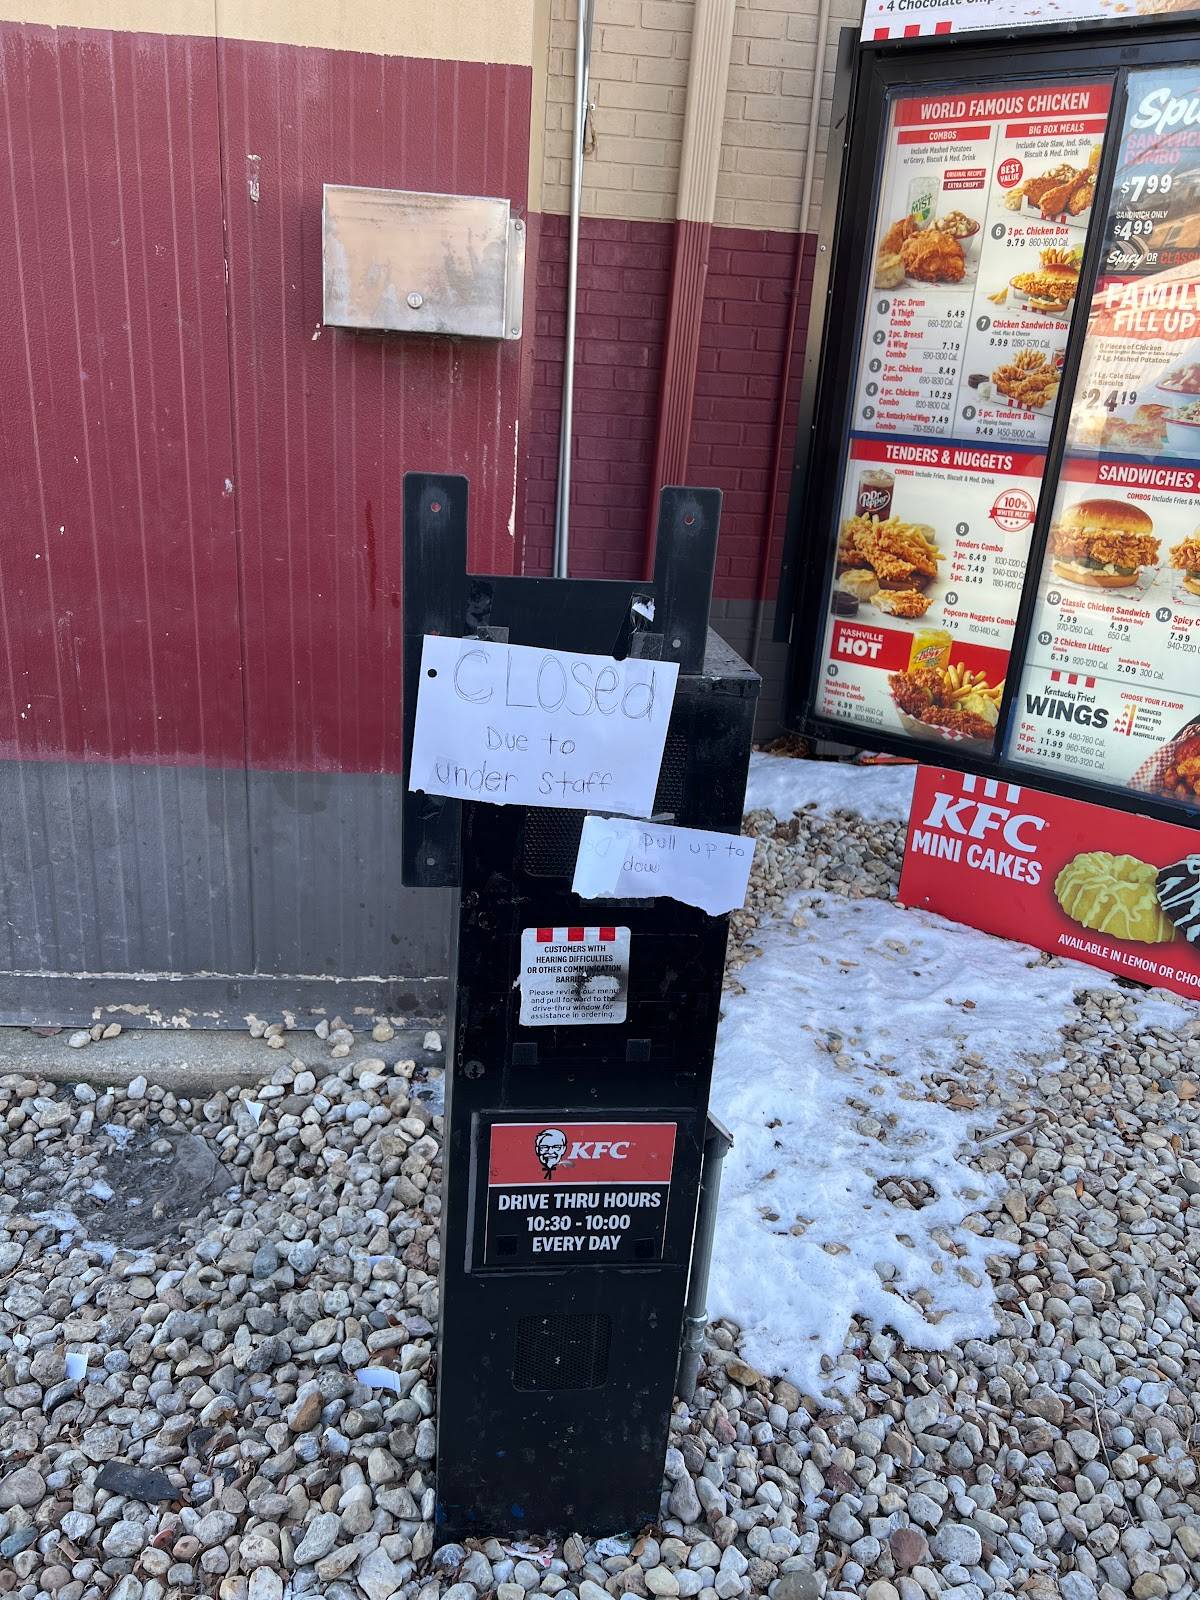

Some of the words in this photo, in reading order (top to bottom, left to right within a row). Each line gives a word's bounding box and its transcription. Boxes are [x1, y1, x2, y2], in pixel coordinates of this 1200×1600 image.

[887, 1, 895, 11] 4
[921, 99, 966, 120] WORLD
[969, 96, 1024, 117] FAMOUS
[1028, 92, 1090, 113] CHICKEN
[1029, 125, 1041, 135] BIG
[1043, 124, 1059, 134] BOX
[1060, 122, 1085, 133] MEALS
[929, 131, 957, 141] COMBOS
[1024, 150, 1043, 158] Biscuit
[1000, 163, 1019, 174] BEST
[1000, 173, 1019, 182] VALUE
[1115, 210, 1150, 219] SANDWICH
[1151, 210, 1168, 218] ONLY
[995, 226, 1001, 236] 6
[1008, 228, 1013, 236] 3
[1026, 226, 1054, 235] Chicken
[1056, 226, 1069, 235] Box
[1006, 238, 1025, 247] 9.79
[1107, 250, 1143, 271] Spicy
[1146, 252, 1158, 262] OR
[898, 309, 914, 318] Thigh
[947, 310, 965, 318] 6.49
[890, 318, 911, 327] Combo
[992, 320, 1020, 329] Chicken
[1021, 320, 1054, 330] Sandwich
[1055, 322, 1069, 330] Box
[1114, 311, 1156, 332] FILL
[1163, 312, 1196, 333] UP
[942, 342, 960, 350] 7.19
[990, 338, 1008, 347] 9.99
[899, 365, 923, 373] Chicken
[939, 367, 956, 375] 8.49
[930, 390, 952, 400] 10.29
[932, 416, 949, 424] 7.49
[996, 410, 1021, 419] Tenders
[1023, 412, 1035, 420] Box
[976, 426, 994, 435] 9.49
[886, 444, 939, 463] TENDERS
[941, 450, 950, 464] &
[953, 451, 1013, 470] NUGGETS
[1099, 464, 1196, 489] SANDWICHES
[1004, 497, 1028, 510] 100%
[1127, 492, 1151, 501] COMBOS
[1152, 495, 1172, 504] Include
[1173, 496, 1188, 505] Fries
[996, 508, 1014, 517] WHITE
[1015, 510, 1030, 519] MEAT
[960, 525, 965, 533] 9
[956, 540, 980, 549] Tenders
[981, 543, 1003, 552] Combo
[969, 554, 987, 562] 6.49
[968, 565, 985, 574] 7.49
[965, 576, 983, 584] 8.49
[948, 594, 955, 603] 10
[1049, 593, 1059, 603] 12
[1061, 598, 1085, 609] Classic
[1087, 602, 1115, 613] Chicken
[1116, 605, 1150, 619] Sandwich
[944, 608, 968, 618] Popcorn
[970, 612, 995, 623] Nuggets
[1160, 610, 1169, 620] 14
[942, 620, 959, 629] 7.19
[1059, 614, 1077, 624] 7.99
[1110, 622, 1129, 632] 4.99
[1173, 615, 1194, 627] Spicy
[840, 628, 883, 642] NASHVILLE
[1041, 633, 1050, 643] 13
[1170, 632, 1190, 642] 7.99
[838, 637, 882, 659] HOT
[1060, 638, 1086, 649] Chicken
[1051, 653, 1069, 663] 6.19
[1117, 665, 1137, 675] 2.09
[1044, 686, 1076, 701] Kentucky
[1077, 691, 1096, 703] Fried
[1120, 692, 1144, 703] CHOOSE
[1144, 696, 1161, 706] YOUR
[1161, 700, 1184, 710] FLAVOR
[1026, 694, 1109, 729] WINGS
[1047, 728, 1065, 738] 6.99
[486, 726, 529, 752] Due
[540, 732, 576, 755] to
[1017, 743, 1024, 751] 24
[1036, 748, 1061, 760] 23.99
[923, 792, 1046, 853] KFC
[725, 841, 745, 856] to
[911, 829, 963, 863] MINI
[966, 844, 1043, 886] CAKES
[544, 945, 587, 954] CUSTOMERS
[587, 944, 606, 953] WITH
[536, 956, 567, 964] HEARING
[568, 954, 614, 963] DIFFICULTIES
[1058, 933, 1109, 959] AVAILABLE
[1110, 949, 1121, 962] IN
[1122, 953, 1158, 973] LEMON
[1158, 965, 1174, 979] OR
[527, 966, 537, 974] OR
[538, 965, 562, 974] OTHER
[546, 996, 562, 1005] pull
[581, 1011, 615, 1019] ordering.
[568, 1141, 631, 1160] KFC
[498, 1193, 550, 1211] DRIVE
[553, 1192, 600, 1209] THRU
[603, 1191, 662, 1208] HOURS
[526, 1215, 572, 1232] 10:30
[585, 1214, 631, 1230] 10:00
[532, 1236, 586, 1253] EVERY
[588, 1235, 622, 1251] DAY
